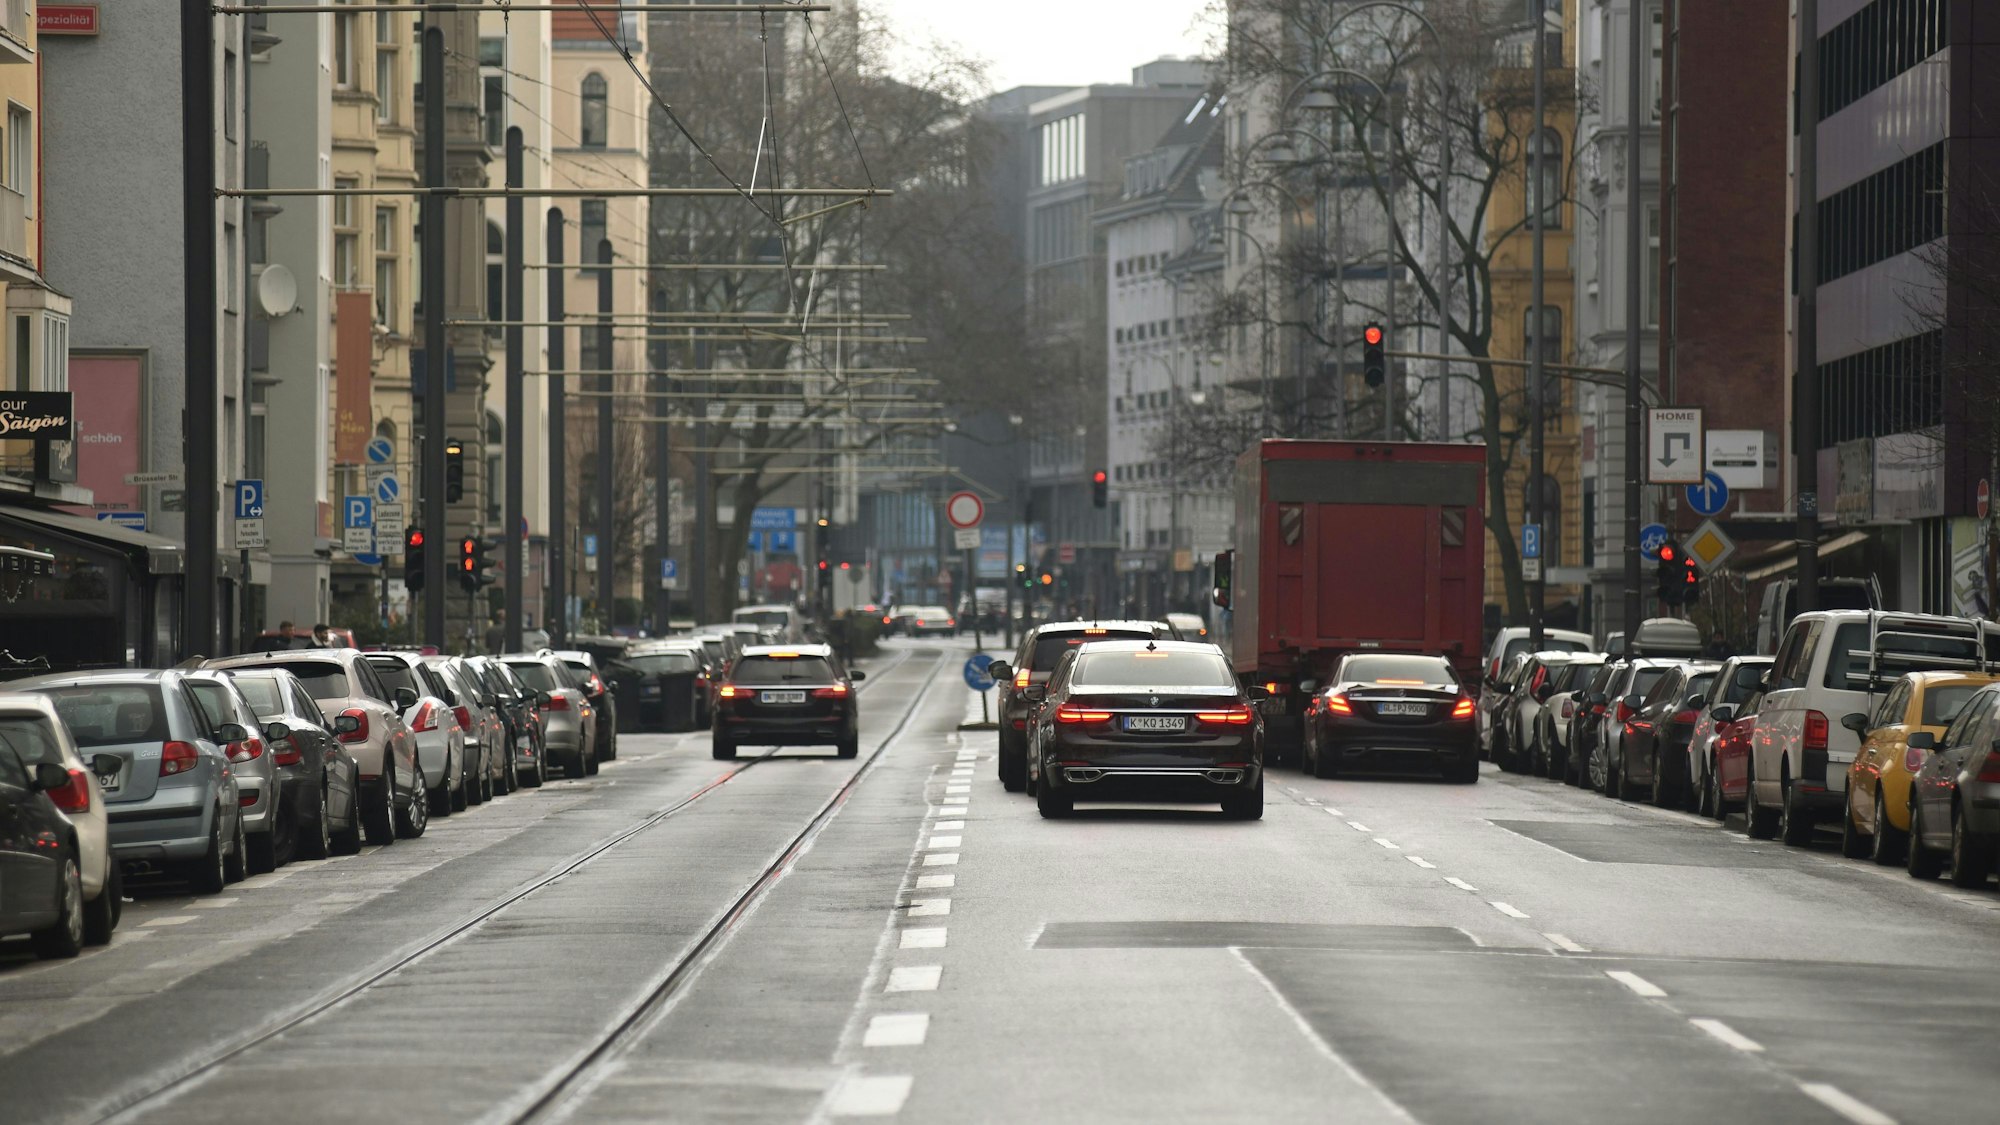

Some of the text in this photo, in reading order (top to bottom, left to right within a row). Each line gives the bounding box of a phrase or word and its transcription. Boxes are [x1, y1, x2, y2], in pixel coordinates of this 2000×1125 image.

[1, 400, 27, 410] our
[1656, 412, 1695, 420] HOME
[82, 433, 122, 443] schön
[133, 474, 166, 482] Brüsseler
[241, 485, 256, 516] P
[350, 501, 366, 527] P
[377, 509, 400, 517] Ladezone
[1526, 529, 1535, 552] P
[665, 561, 673, 575] P
[1130, 718, 1184, 728] K KQ 1349
